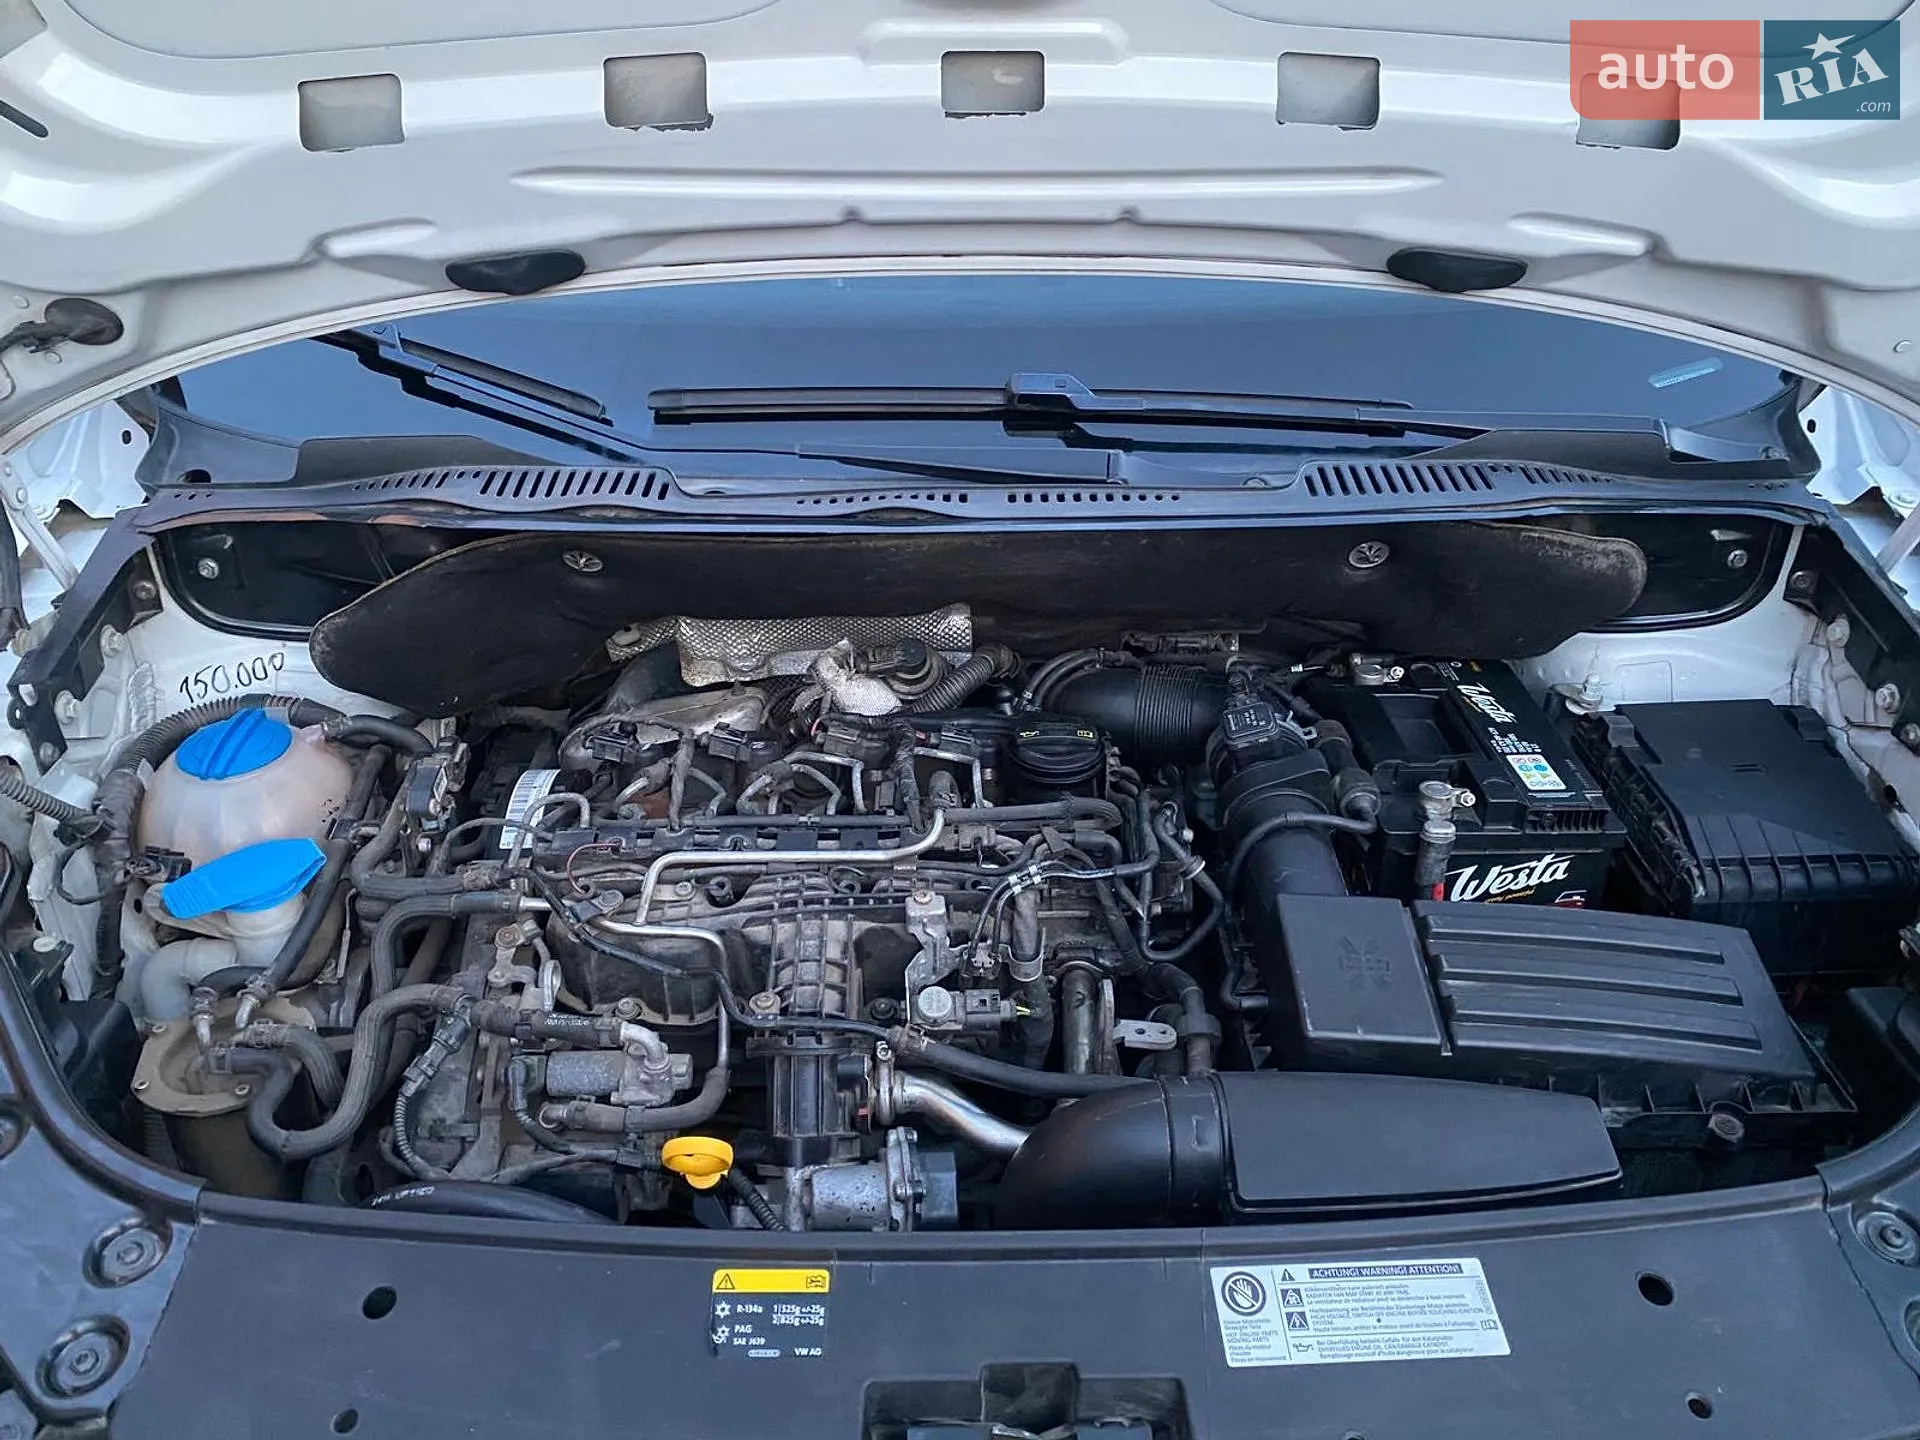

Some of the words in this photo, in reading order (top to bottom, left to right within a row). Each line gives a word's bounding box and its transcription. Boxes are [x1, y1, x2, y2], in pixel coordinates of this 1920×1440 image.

[179, 652, 284, 704] 150.000
[1457, 682, 1517, 723] Westa
[1445, 854, 1577, 903] Westa
[1360, 1266, 1407, 1275] WARNING!
[736, 1304, 764, 1314] R-134a
[734, 1324, 753, 1334] PAG
